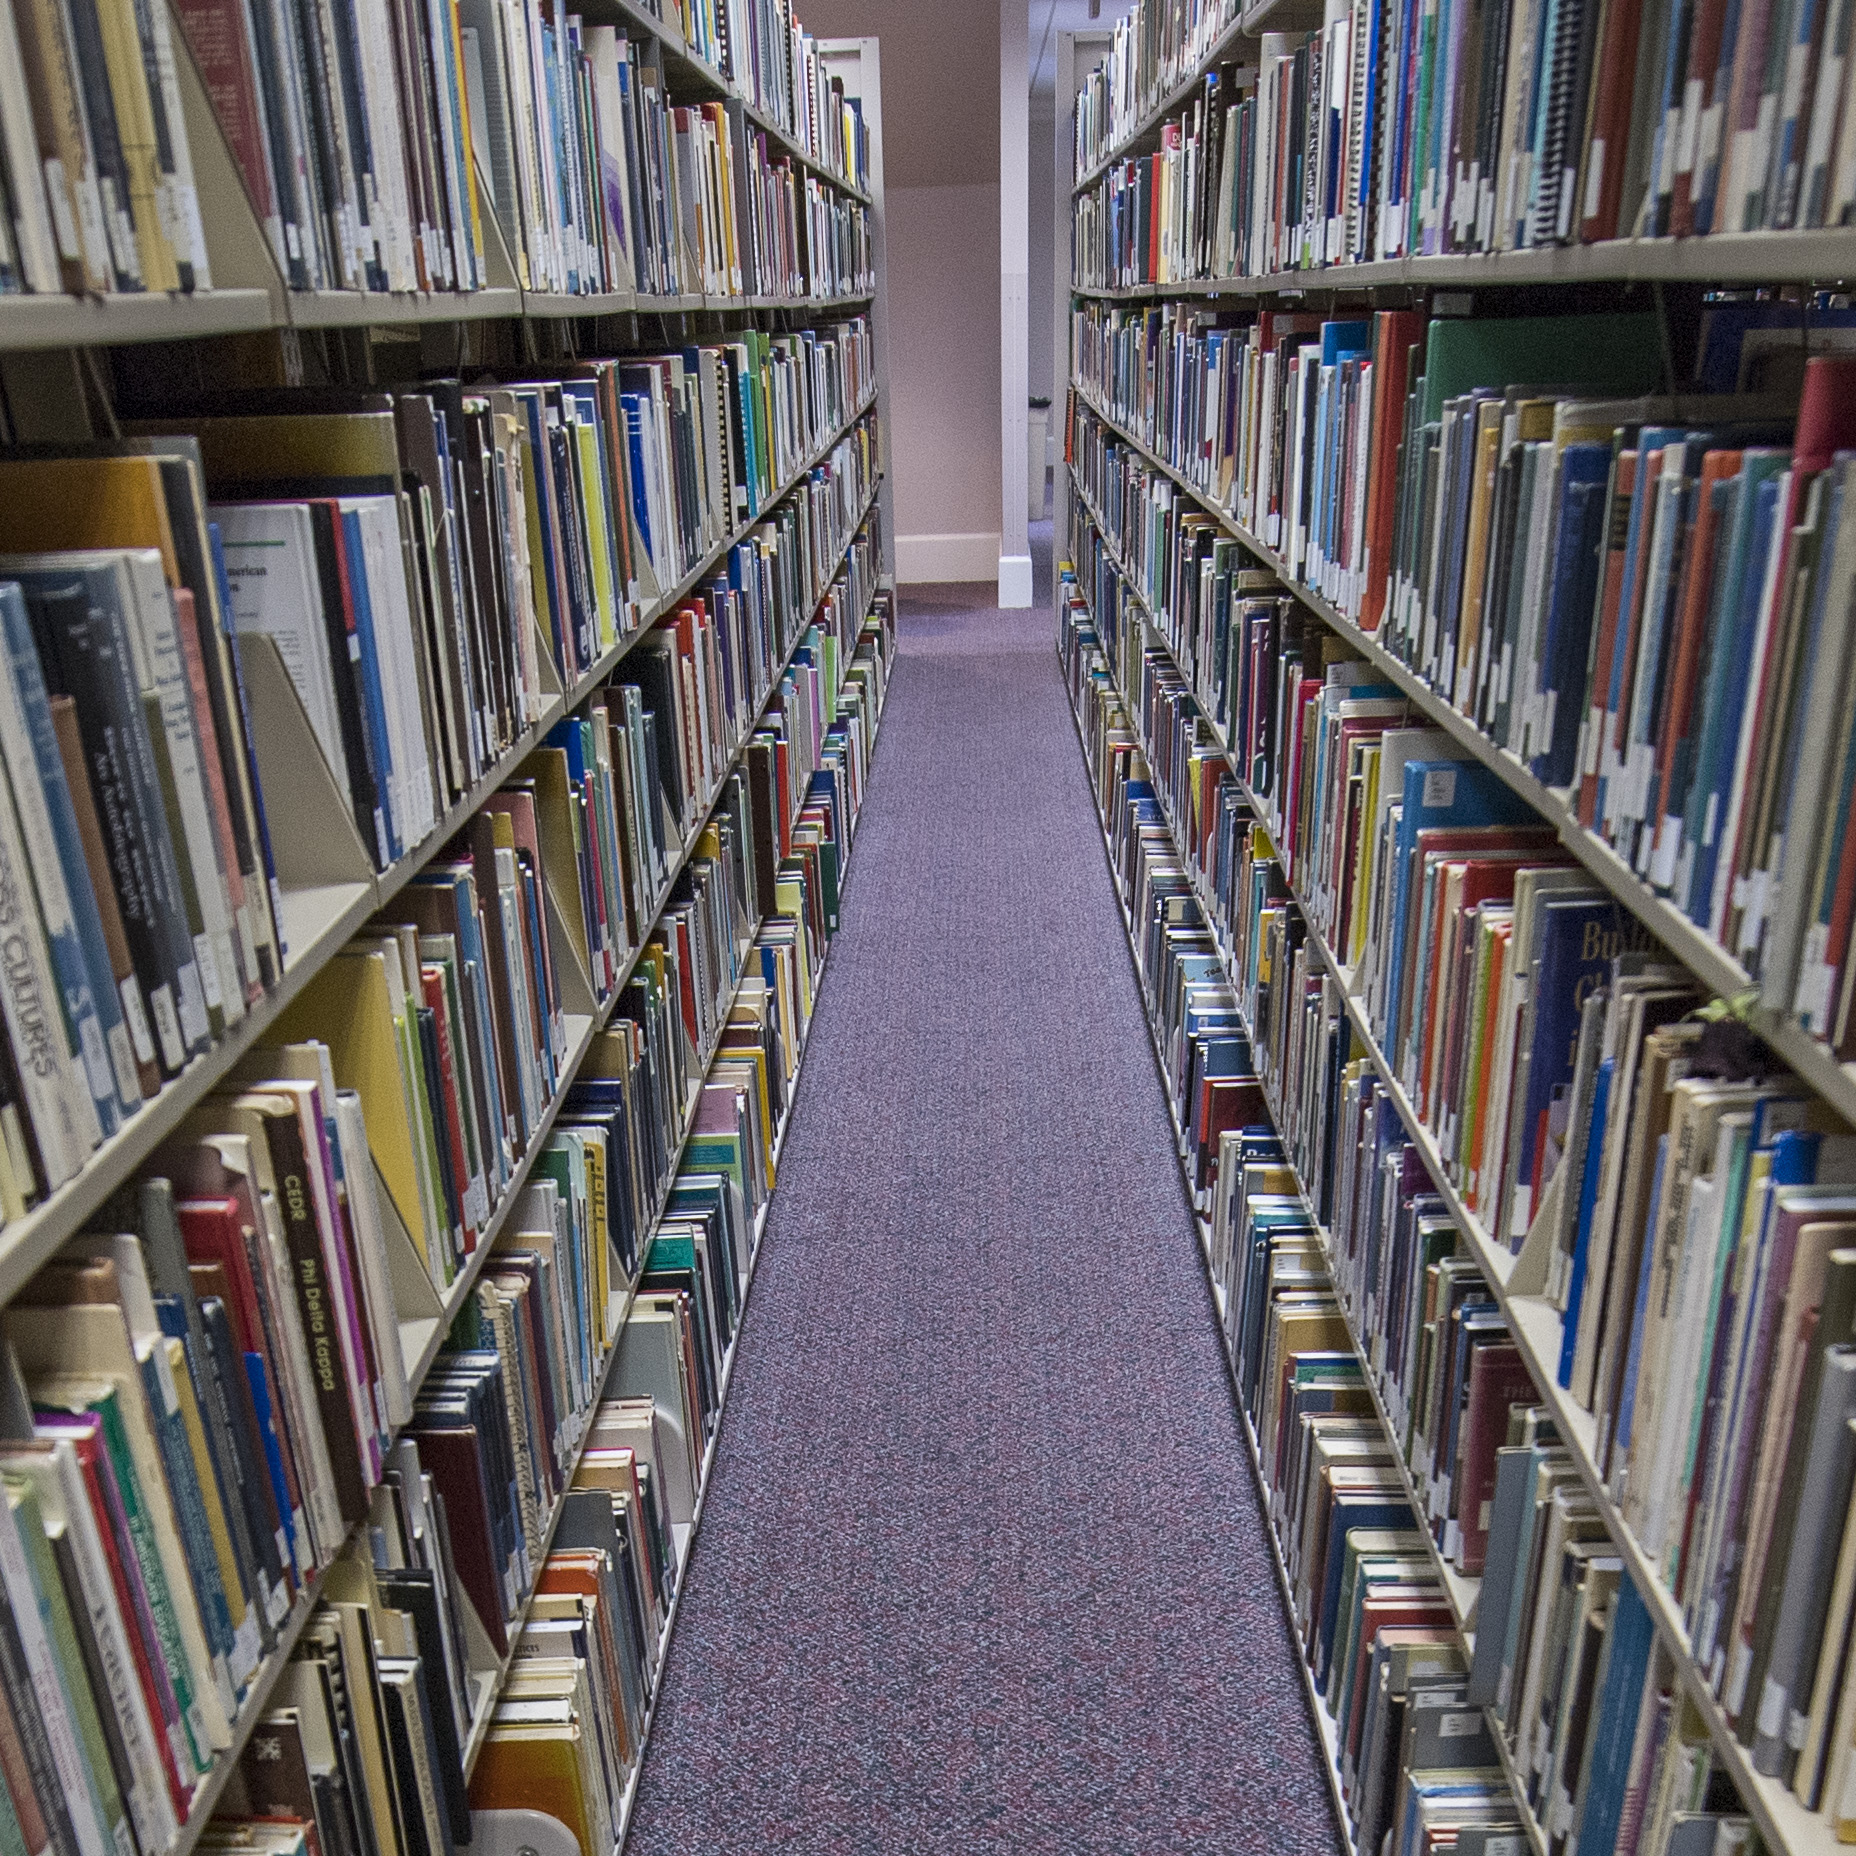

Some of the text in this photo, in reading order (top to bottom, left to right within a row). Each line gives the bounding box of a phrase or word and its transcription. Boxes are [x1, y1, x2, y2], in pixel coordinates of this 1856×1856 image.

[227, 565, 267, 577] merican
[98, 781, 147, 924] Autobiography
[284, 1175, 337, 1392] CEDR Phi Delta Kappa
[89, 1604, 140, 1748] Teacher
